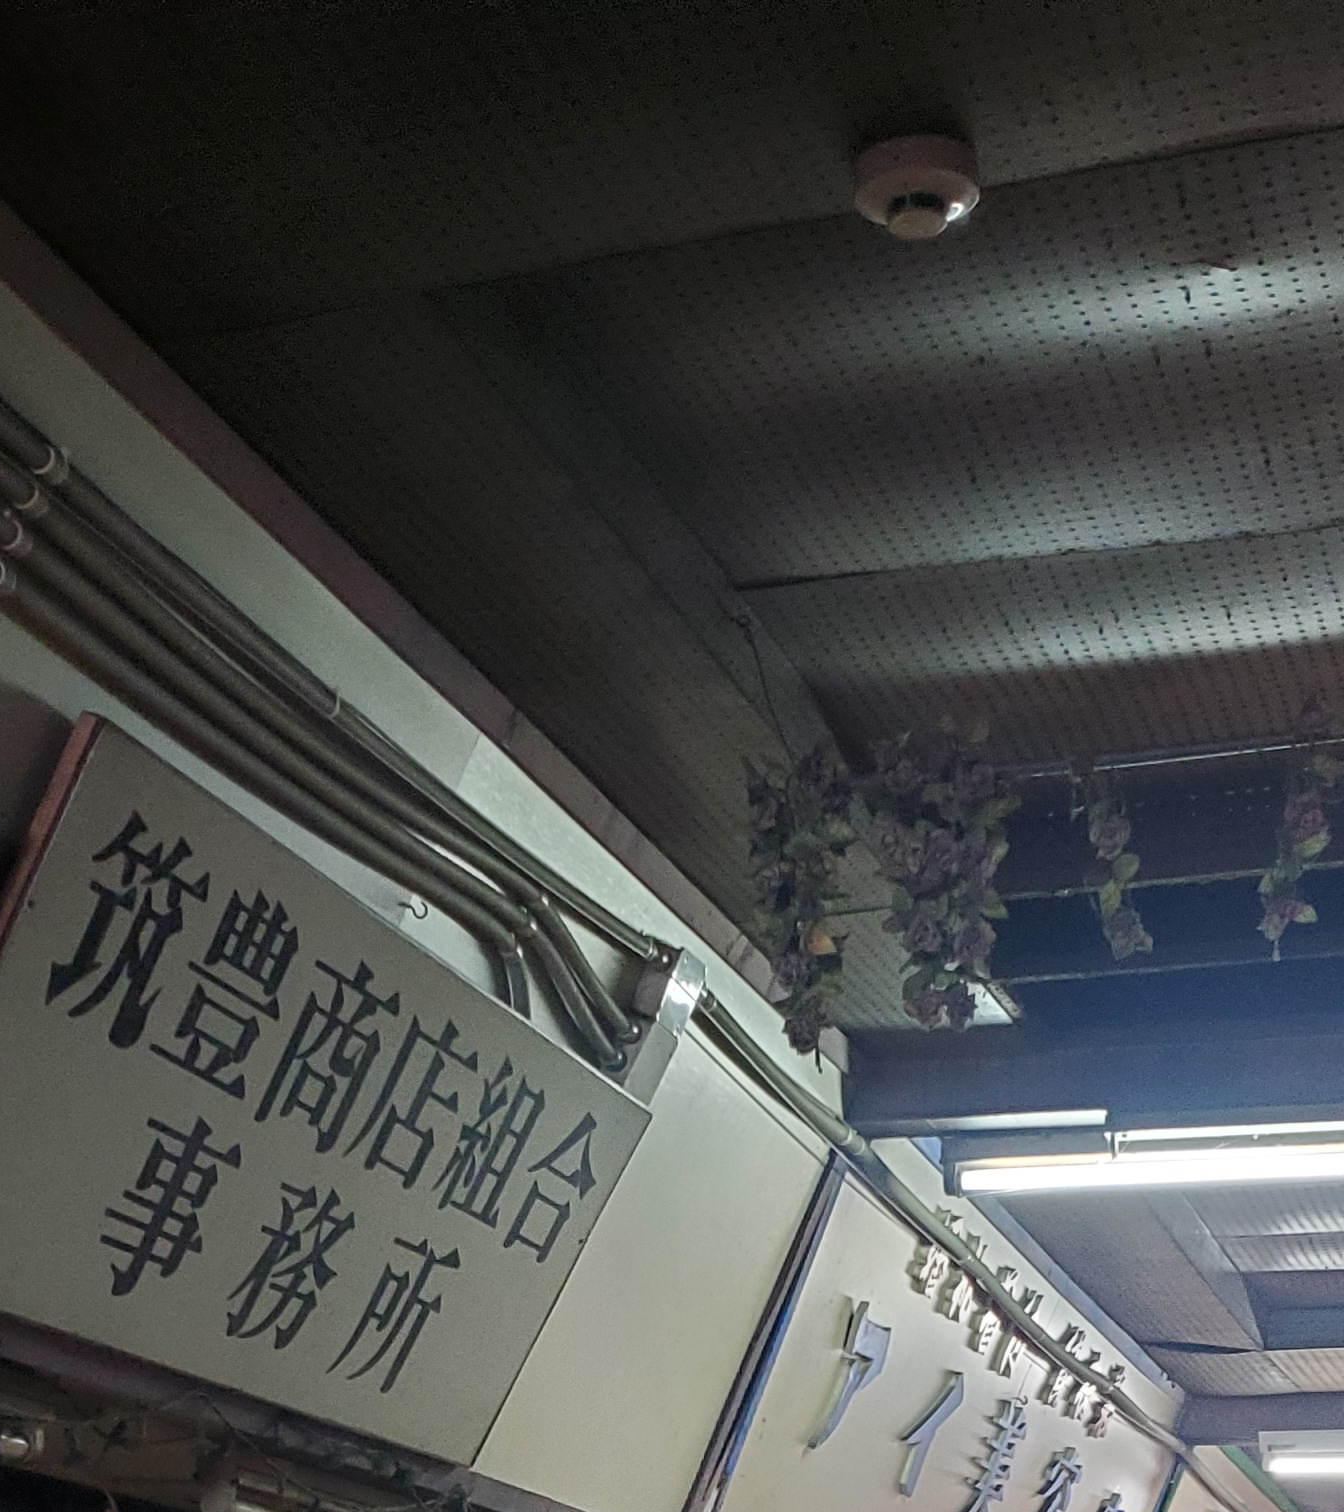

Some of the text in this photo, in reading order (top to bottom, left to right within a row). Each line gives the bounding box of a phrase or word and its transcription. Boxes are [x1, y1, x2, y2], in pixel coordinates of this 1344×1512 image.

[45, 810, 598, 1263] 筑豊商店組合
[99, 1116, 461, 1394] 事務所
